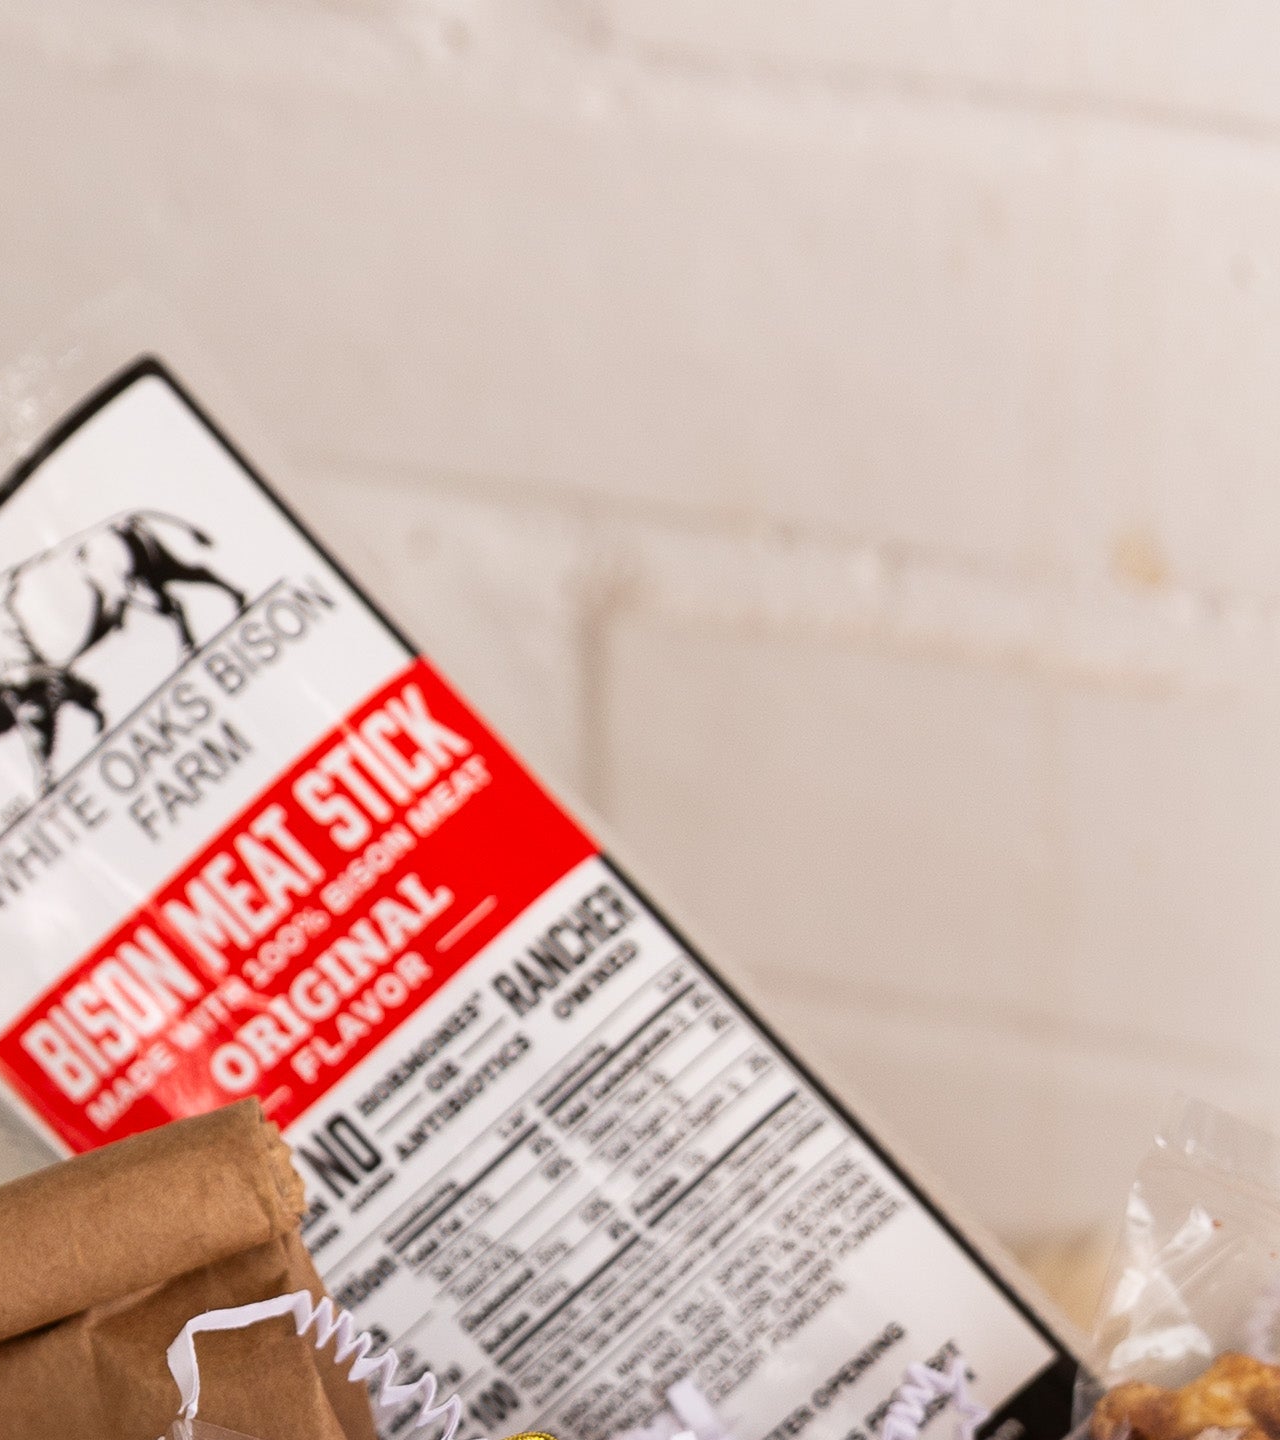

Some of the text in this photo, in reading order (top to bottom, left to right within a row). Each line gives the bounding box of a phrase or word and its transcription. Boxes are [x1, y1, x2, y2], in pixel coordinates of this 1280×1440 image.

[94, 680, 211, 797] OAKS
[204, 577, 332, 694] BISON
[129, 721, 249, 839] FARM
[22, 682, 470, 1102] BISON MEAT STICK
[86, 756, 491, 1129] MADE WITH 100% BISON MEAT
[495, 884, 632, 1013] RANCHER
[206, 864, 453, 1098] ORIGINAL
[291, 951, 432, 1081] FLAVOR
[555, 942, 637, 1019] OWNED
[300, 1112, 380, 1196] NO
[396, 1035, 528, 1158] ANTIBIOTICS
[813, 1324, 901, 1407] OPENING
